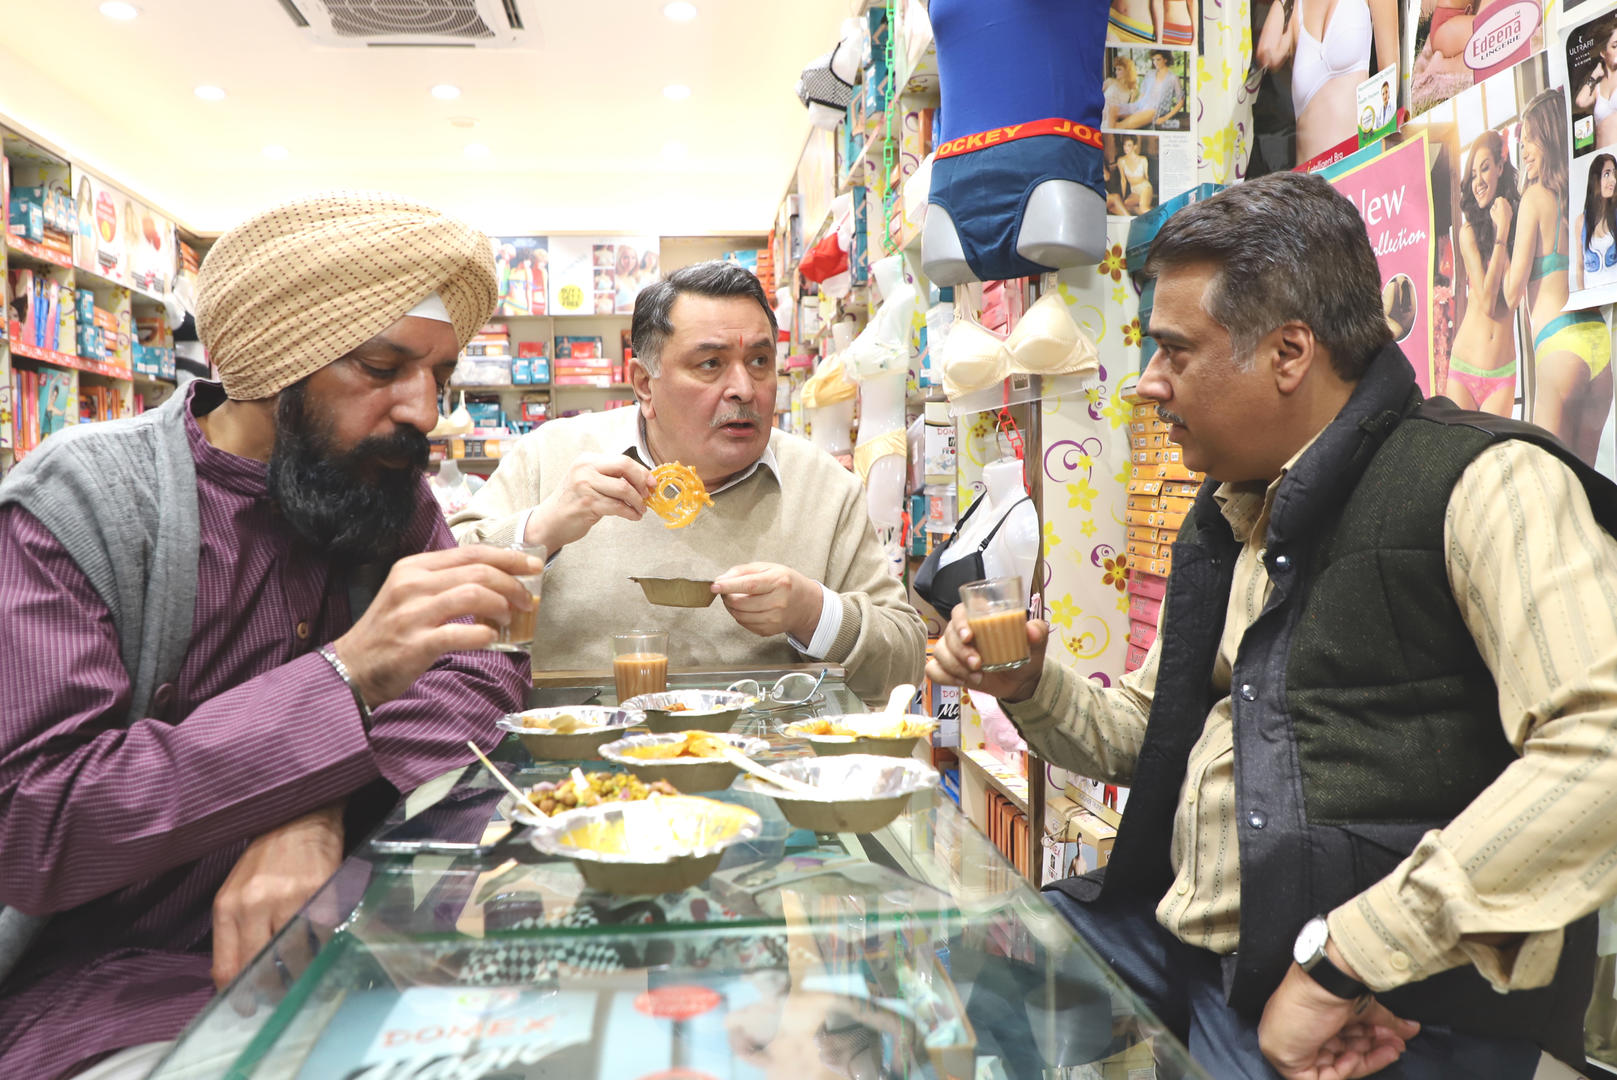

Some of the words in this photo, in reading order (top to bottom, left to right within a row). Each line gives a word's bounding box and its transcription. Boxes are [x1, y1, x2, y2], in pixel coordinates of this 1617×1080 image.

[1473, 20, 1521, 57] Edeena
[1481, 35, 1520, 60] LINGERIE
[1569, 38, 1594, 56] ULTRAFIT
[1370, 228, 1426, 256] ollection
[383, 1015, 554, 1046] DOMEX
